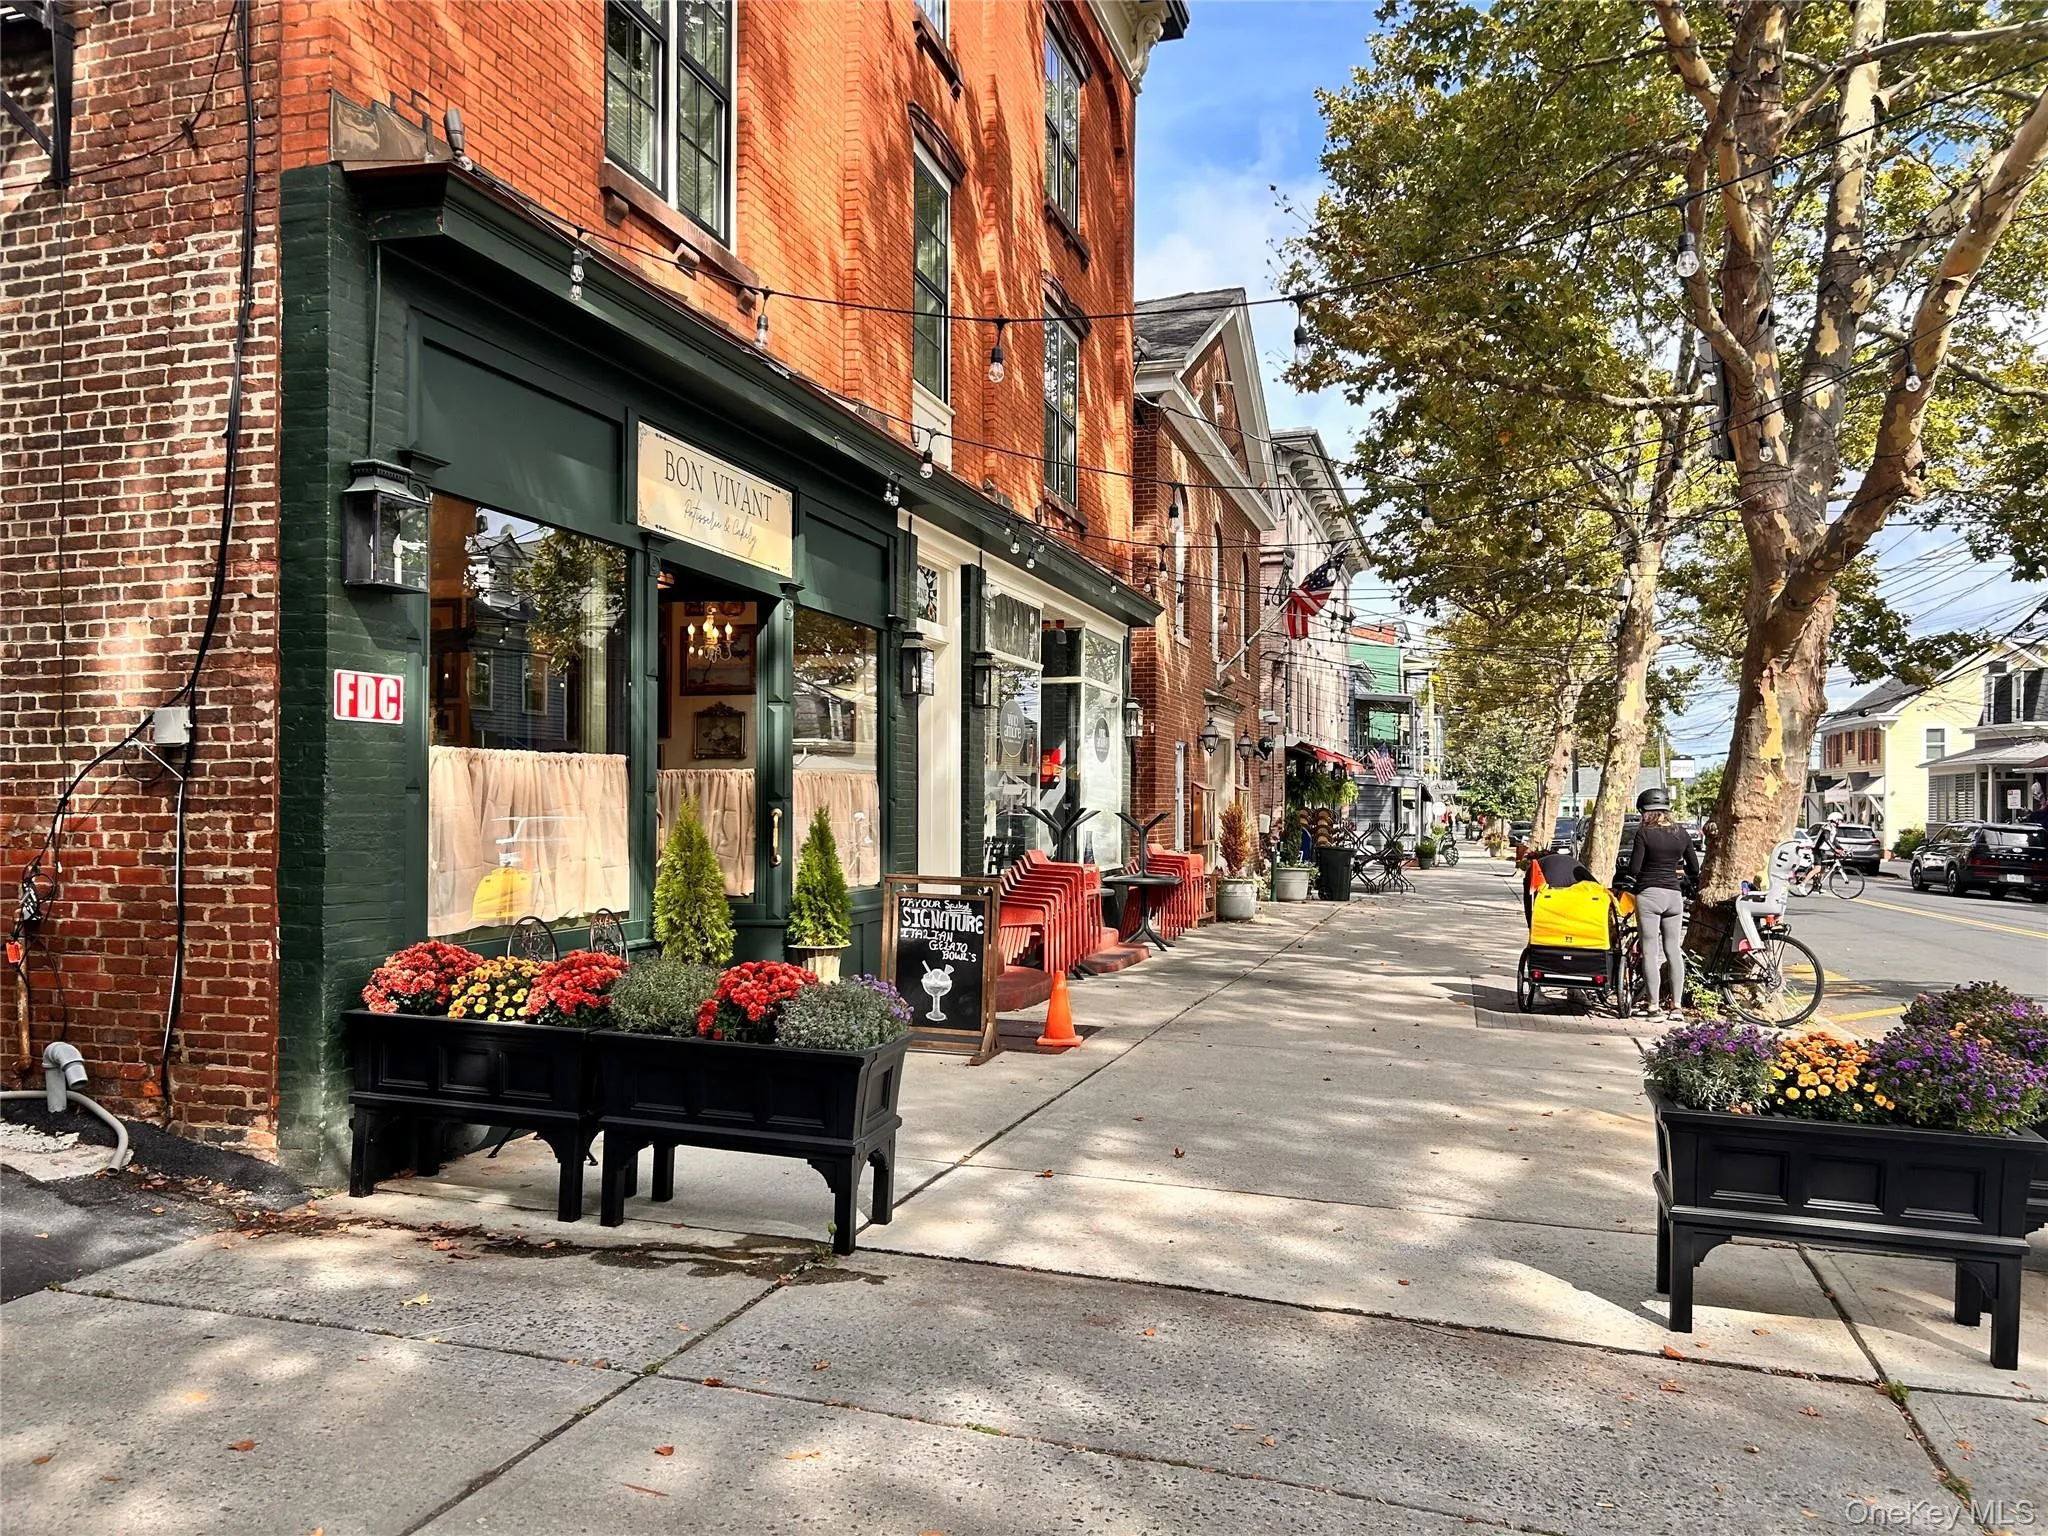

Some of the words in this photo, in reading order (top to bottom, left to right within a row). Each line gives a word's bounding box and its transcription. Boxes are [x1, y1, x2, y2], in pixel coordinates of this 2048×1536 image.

[664, 449, 704, 494] BON
[712, 470, 772, 522] VIVANT
[340, 673, 398, 720] FDC
[921, 899, 942, 909] OUR
[902, 907, 985, 935] SIGNATURE
[900, 928, 954, 943] ITALIAN
[929, 940, 969, 953] GELATO
